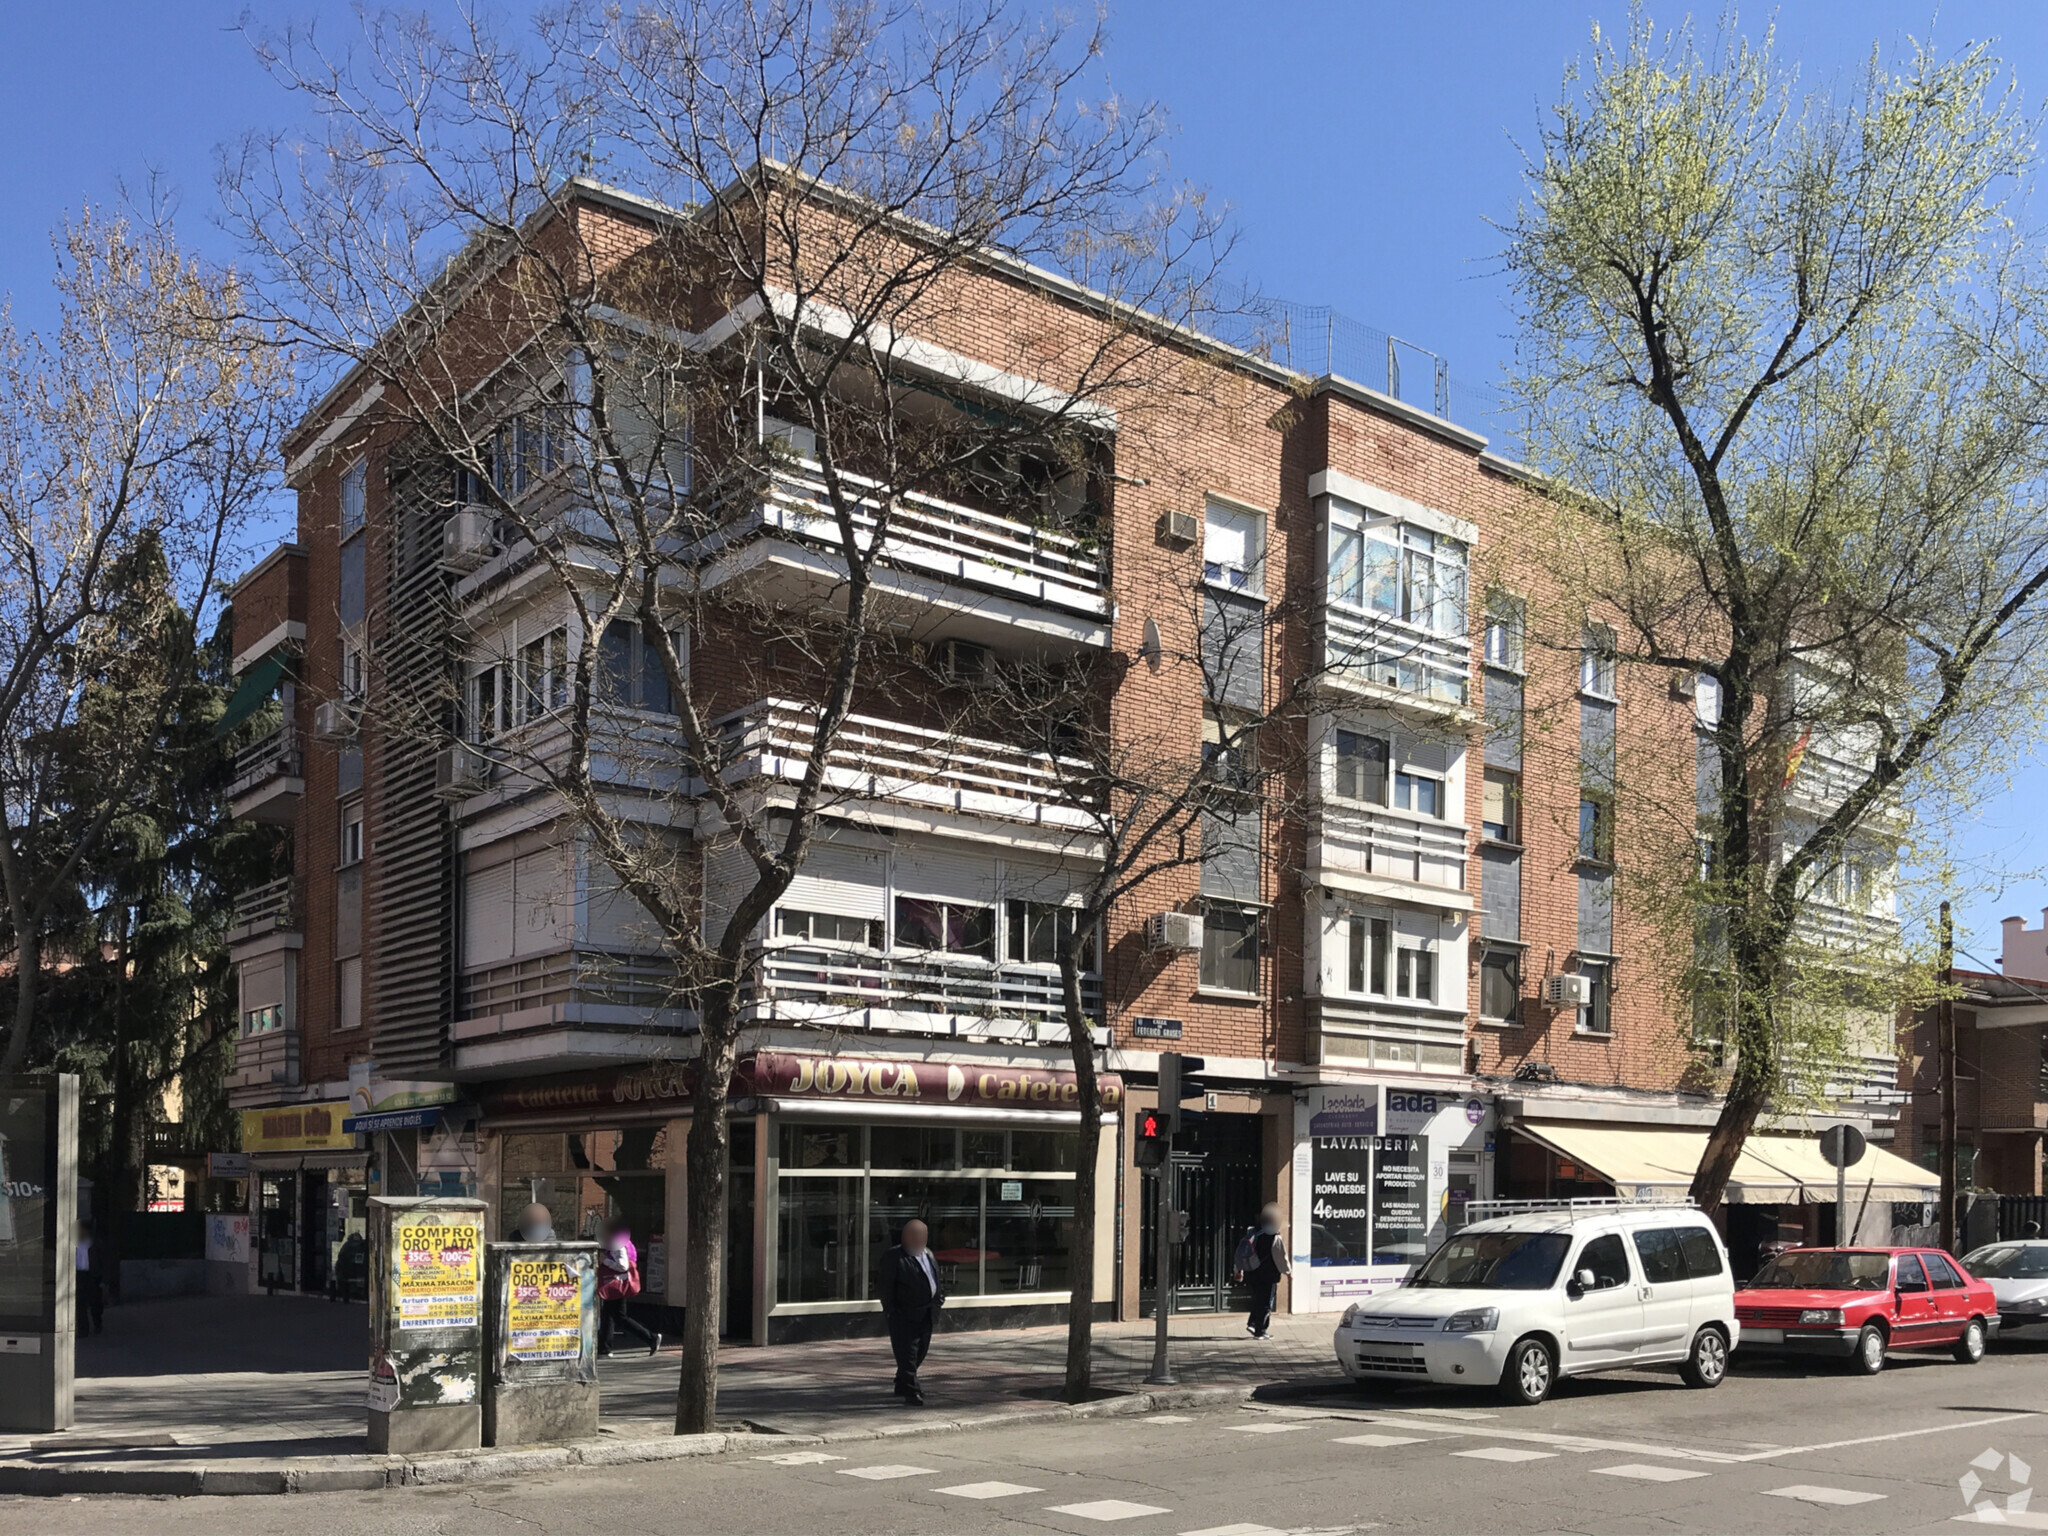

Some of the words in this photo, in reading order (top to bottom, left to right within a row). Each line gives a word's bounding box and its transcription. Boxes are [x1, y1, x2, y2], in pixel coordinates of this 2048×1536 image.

[1137, 1027, 1161, 1036] FEDERICO
[789, 1058, 921, 1097] JOYCA
[978, 1073, 1120, 1105] Cafetea
[1325, 1172, 1346, 1182] LAVE
[1347, 1172, 1359, 1182] SU
[1315, 1185, 1338, 1194] ROPA
[1339, 1185, 1366, 1194] DESDE
[403, 1227, 474, 1238] COMPRO
[402, 1239, 430, 1251] ORO
[434, 1238, 474, 1250] PLATA
[514, 1264, 567, 1274] COMPR
[513, 1274, 536, 1286] ORO
[402, 1318, 435, 1326] ENFRENTE
[512, 1313, 543, 1321] MÁXIMA
